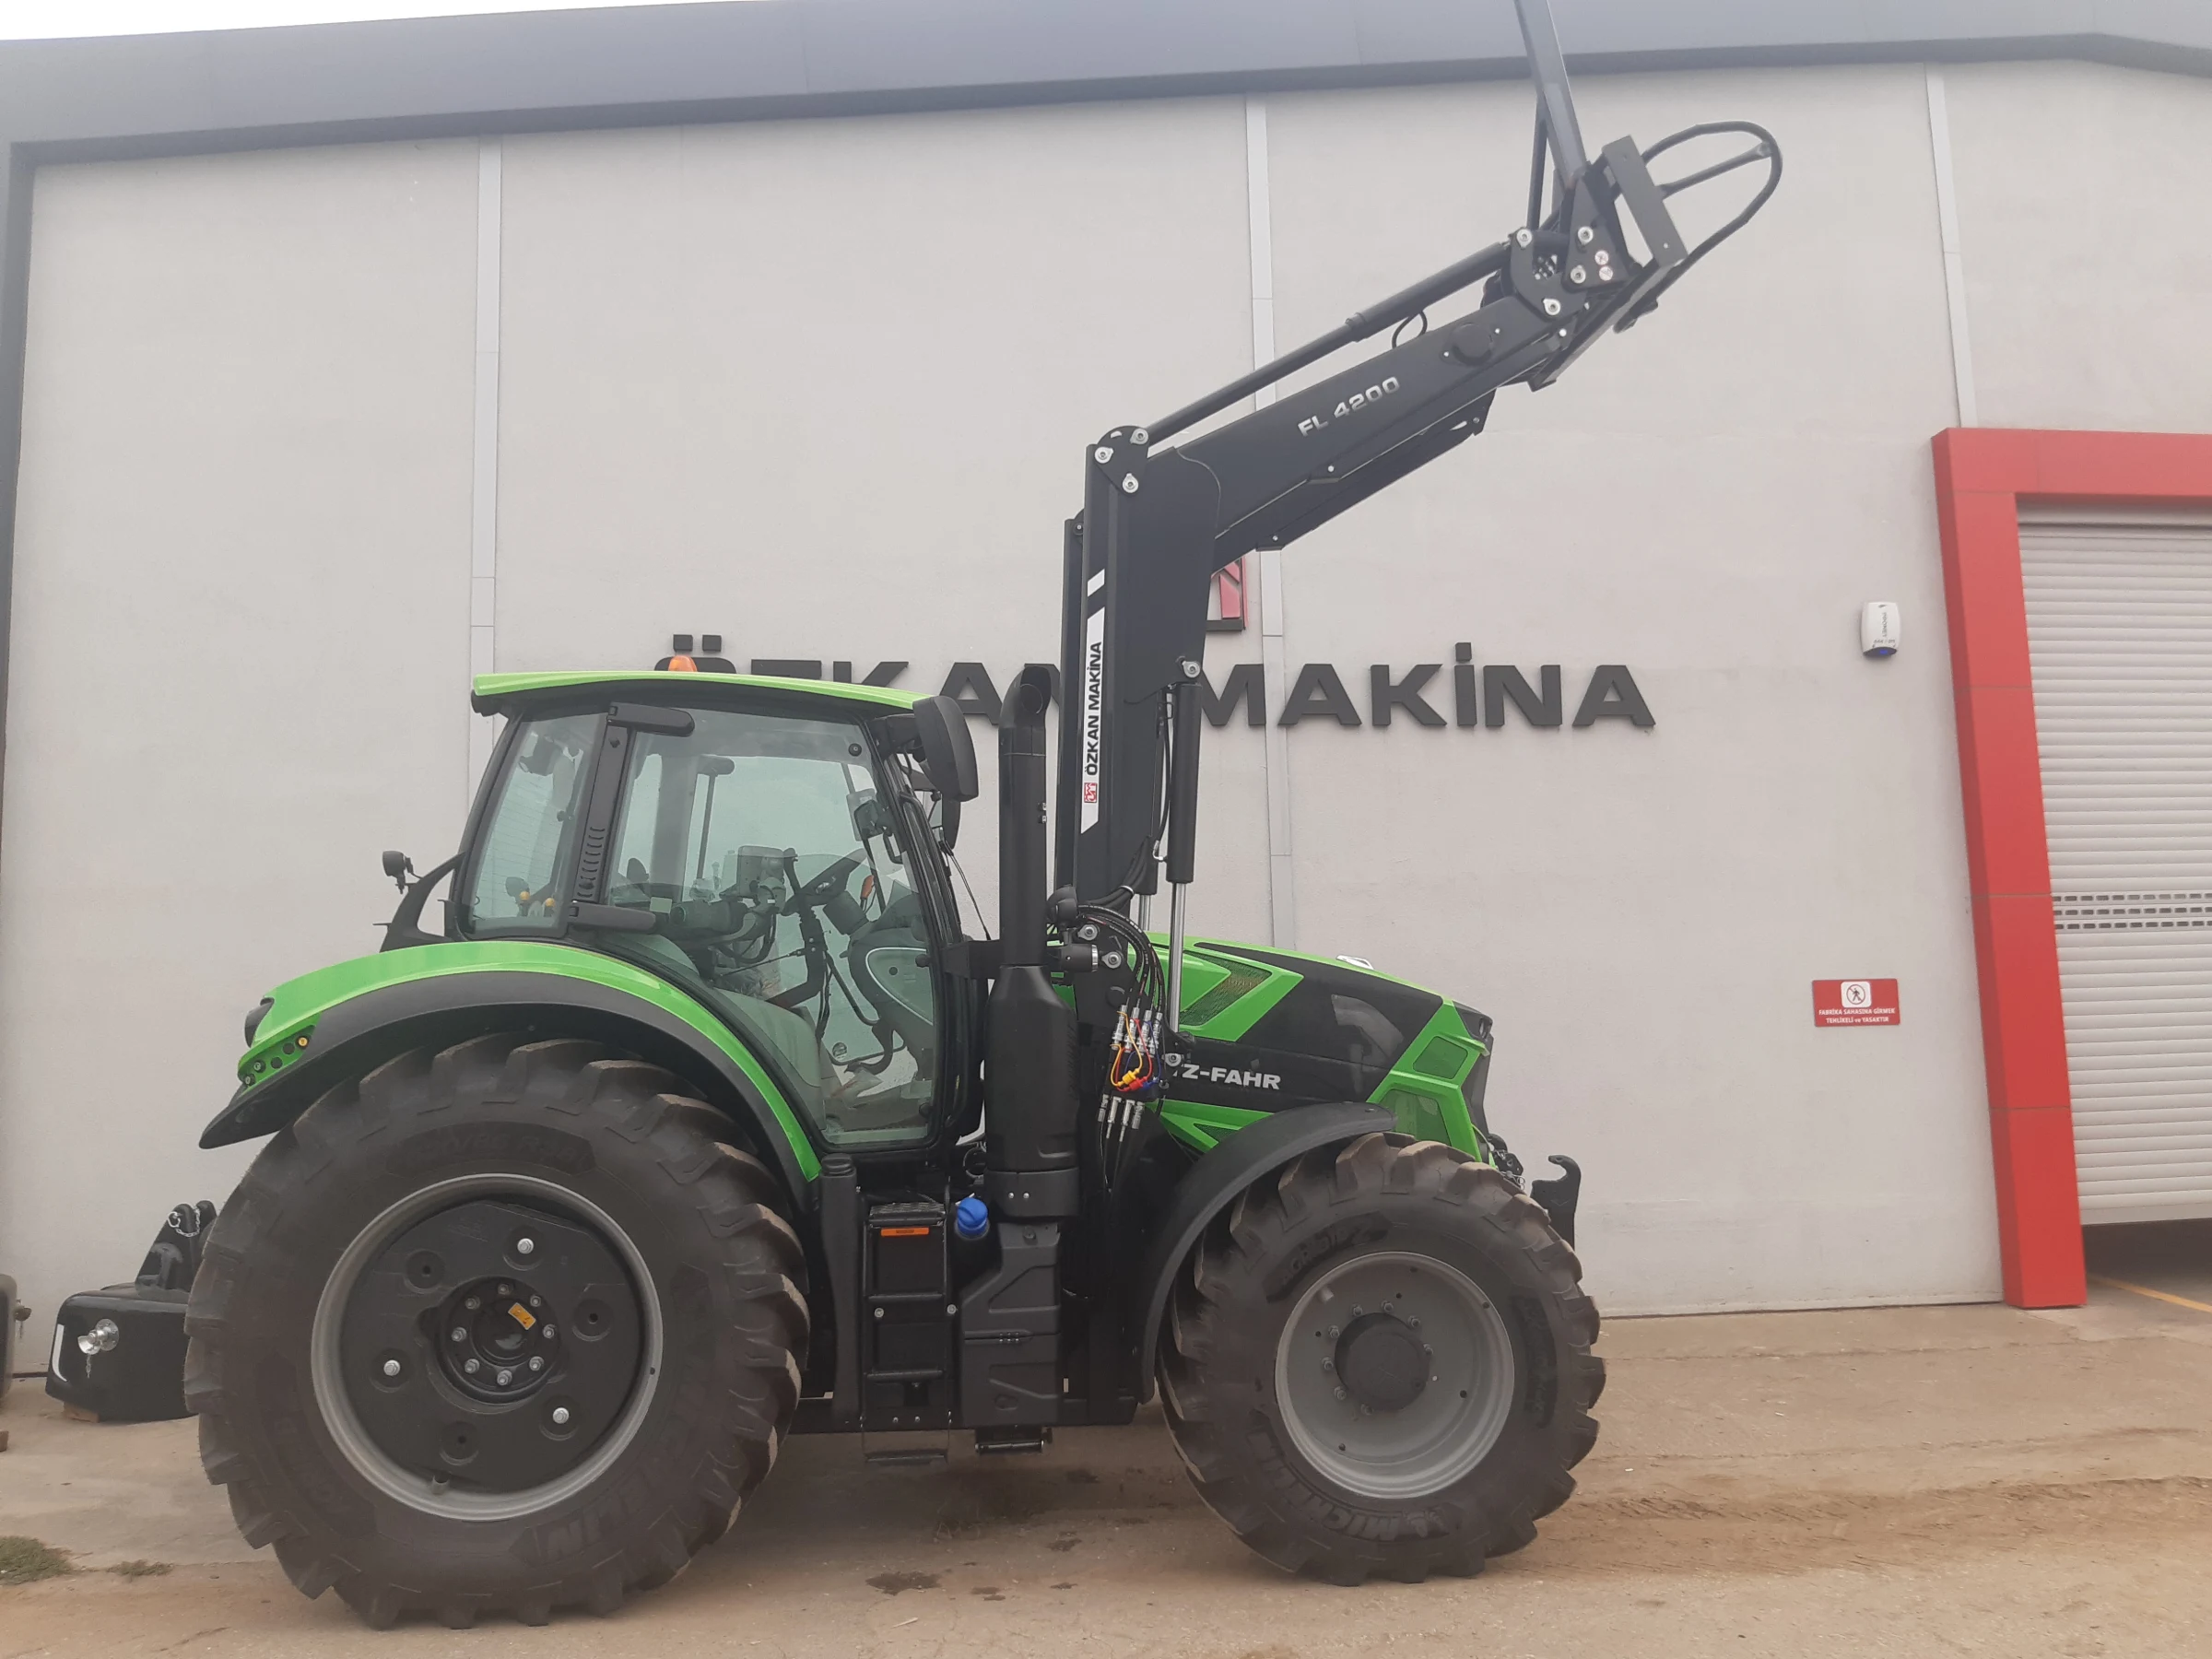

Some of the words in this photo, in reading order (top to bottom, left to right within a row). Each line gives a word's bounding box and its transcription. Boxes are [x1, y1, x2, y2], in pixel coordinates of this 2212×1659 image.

[1298, 416, 1328, 437] FL
[1334, 376, 1399, 418] 4200
[1087, 642, 1101, 710] MAKİNA
[1084, 715, 1099, 775] ÖZKAN
[1172, 1063, 1281, 1090] Z-FAHR
